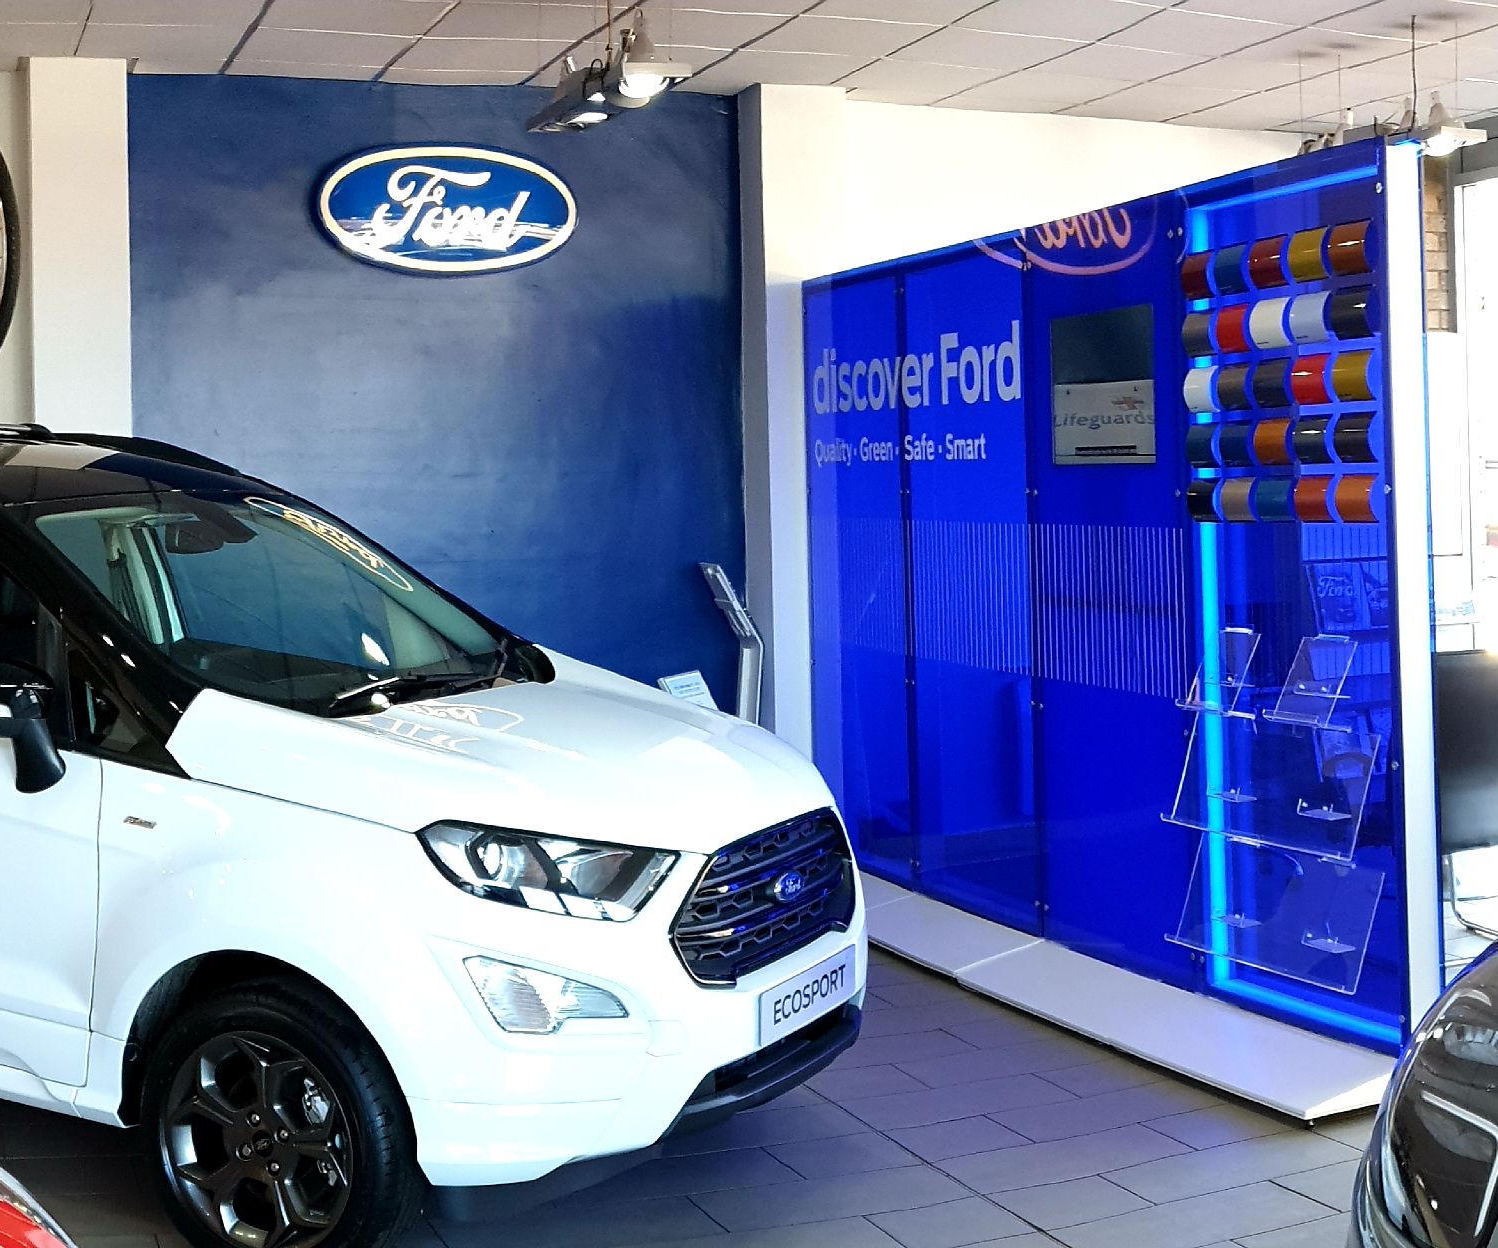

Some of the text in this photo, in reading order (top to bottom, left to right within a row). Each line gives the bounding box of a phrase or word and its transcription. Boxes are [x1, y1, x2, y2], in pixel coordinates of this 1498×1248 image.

[366, 165, 511, 251] Ford
[812, 319, 1022, 415] discover Ford
[814, 433, 987, 467] Quality Green Safe Smart
[1054, 410, 1155, 430] Lifeguards
[773, 963, 847, 1026] ECOSPORT
